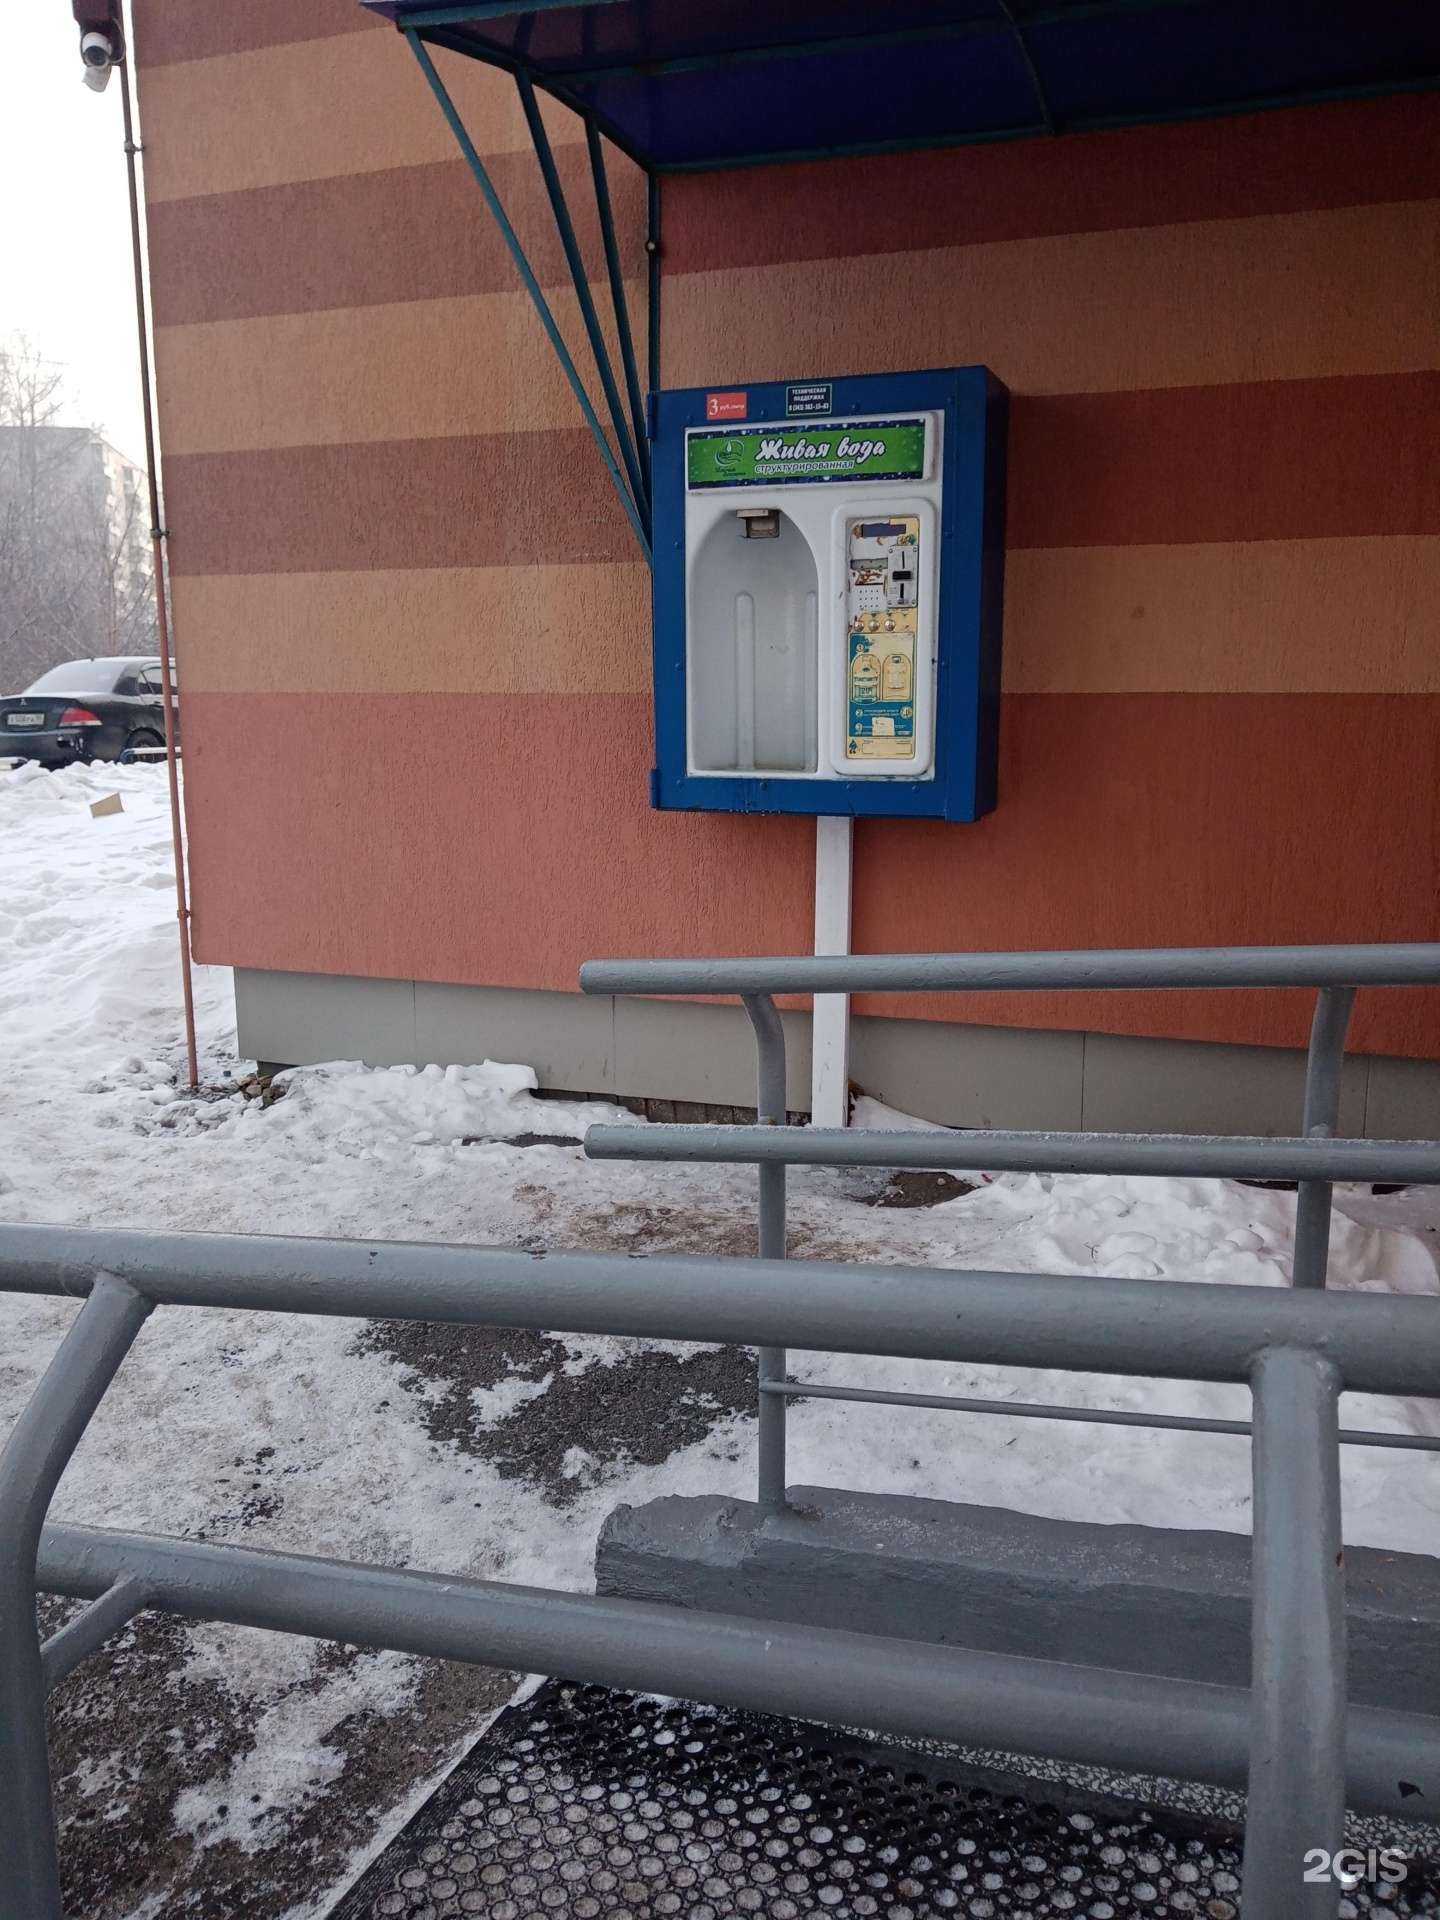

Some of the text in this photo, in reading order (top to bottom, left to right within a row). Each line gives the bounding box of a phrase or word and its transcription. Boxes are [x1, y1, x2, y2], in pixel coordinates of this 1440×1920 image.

[709, 398, 719, 416] 3
[756, 437, 885, 463] Живая вода
[755, 461, 854, 475] структурированная
